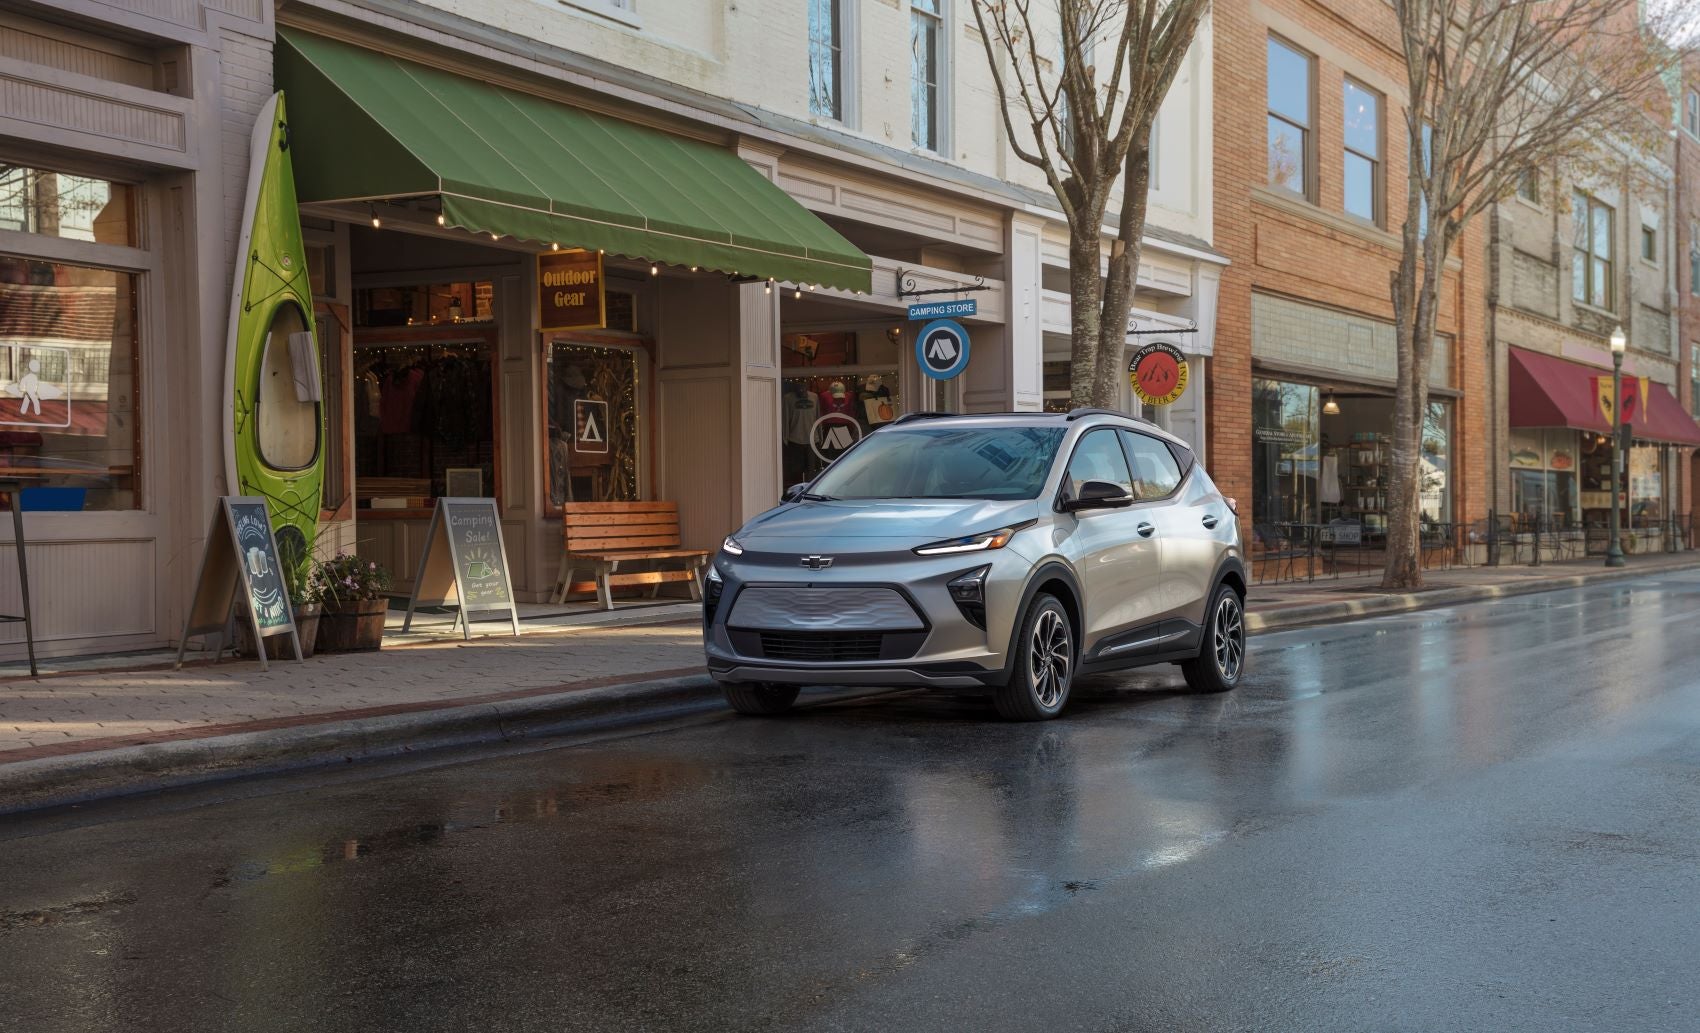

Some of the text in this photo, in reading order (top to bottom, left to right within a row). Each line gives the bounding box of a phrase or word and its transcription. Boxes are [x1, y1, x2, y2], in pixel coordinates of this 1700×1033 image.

[543, 270, 596, 287] Outdoor
[554, 291, 586, 308] Gear
[910, 303, 974, 316] CAMPING STORE
[1140, 345, 1156, 355] Trap
[1156, 343, 1184, 362] Brewing
[1130, 373, 1147, 400] CRAFT
[1147, 396, 1169, 405] BEER
[451, 514, 493, 528] Camping
[465, 530, 490, 543] Sale!
